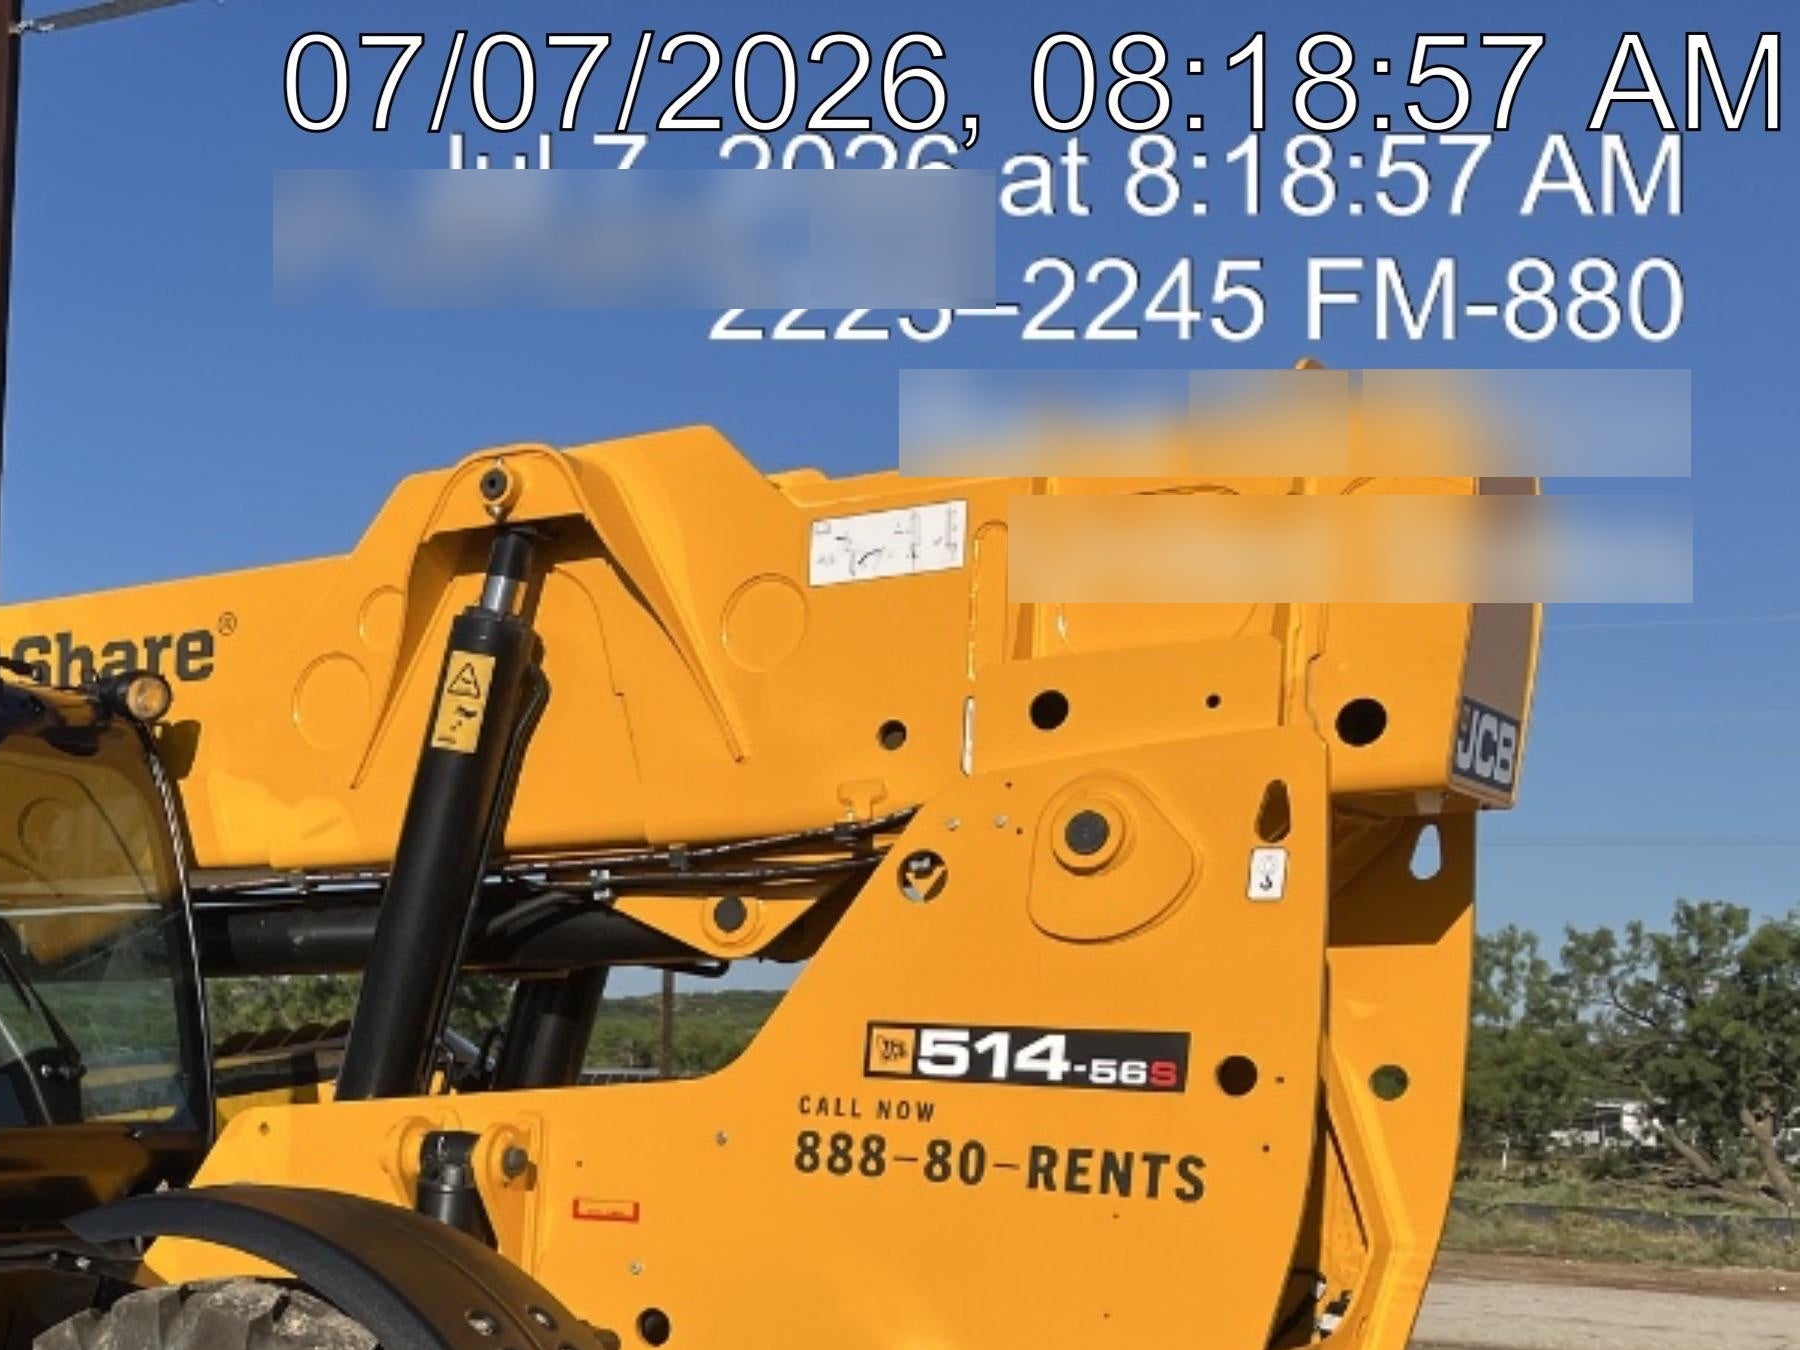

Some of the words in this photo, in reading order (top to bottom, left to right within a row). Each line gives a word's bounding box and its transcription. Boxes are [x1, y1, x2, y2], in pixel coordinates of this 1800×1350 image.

[1457, 710, 1516, 784] JCB
[916, 1028, 1177, 1087] 514-56S
[799, 1095, 862, 1119] CALL
[876, 1100, 936, 1123] NOW
[794, 1130, 1206, 1203] 888-80-RENTS
